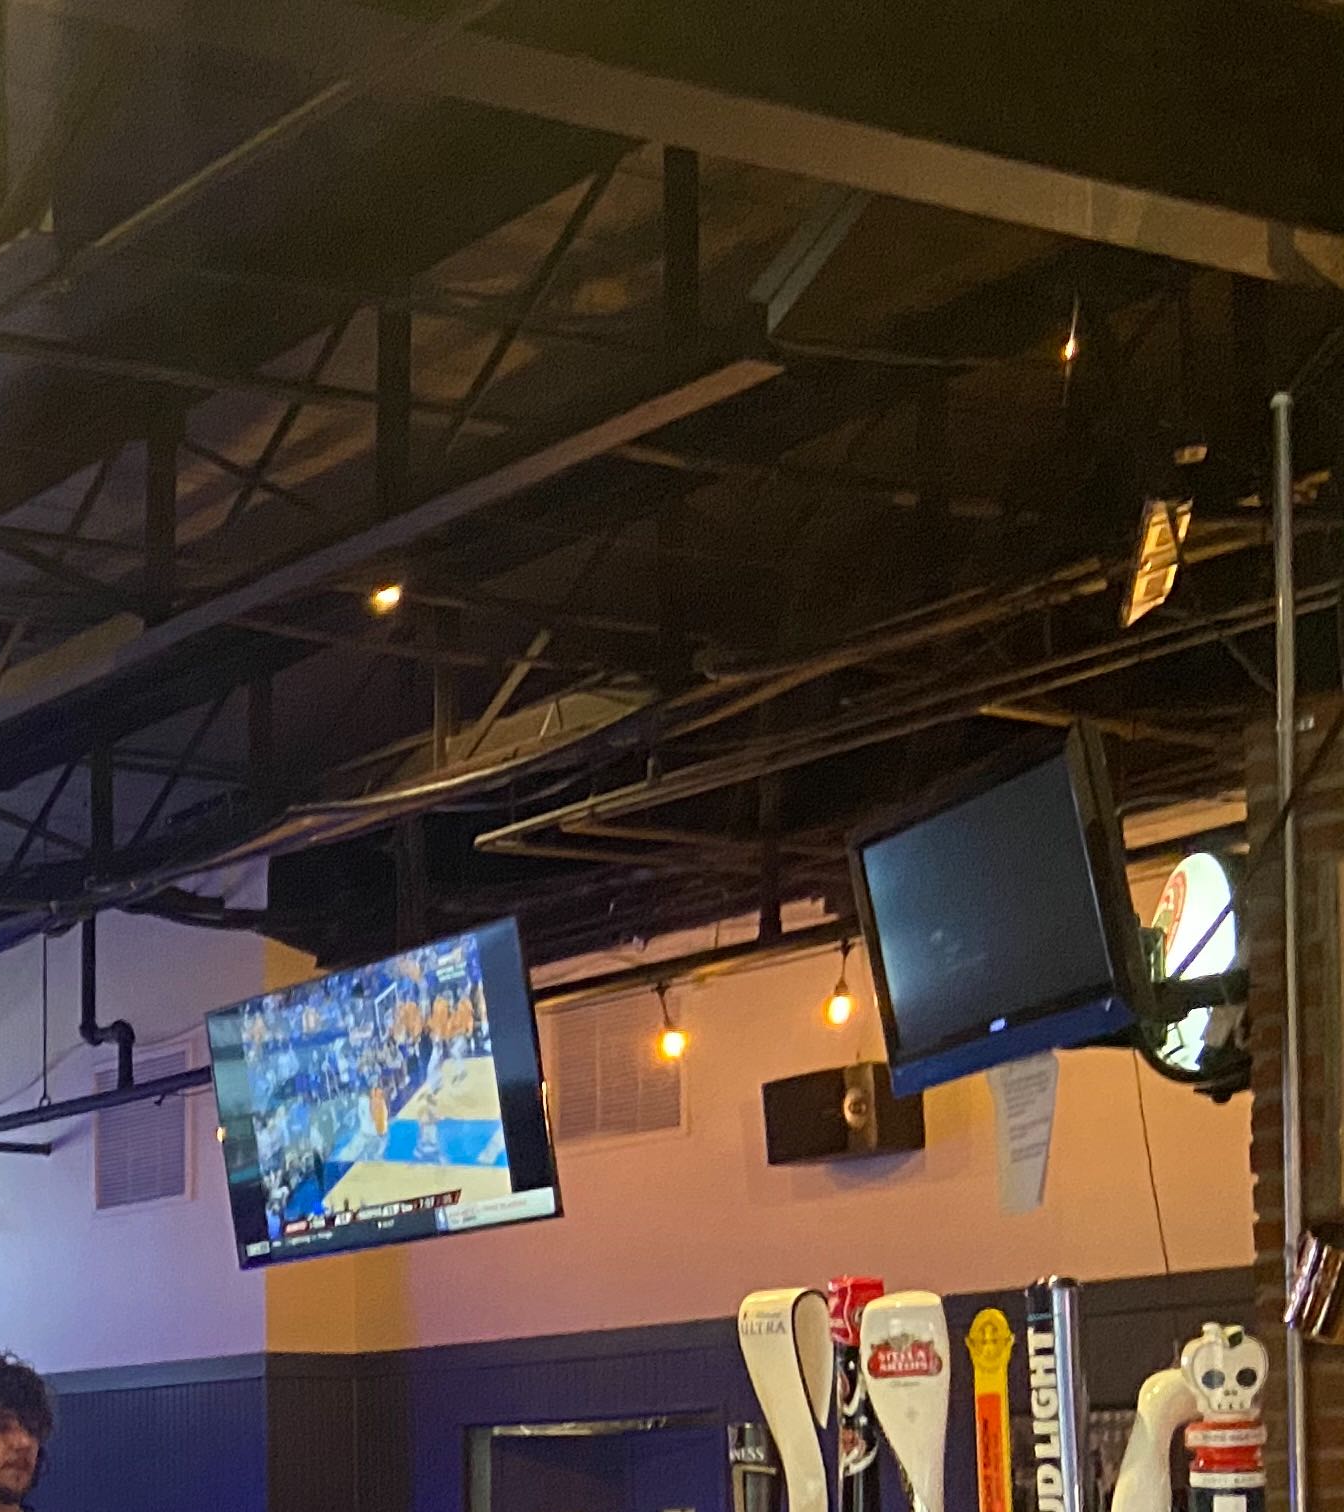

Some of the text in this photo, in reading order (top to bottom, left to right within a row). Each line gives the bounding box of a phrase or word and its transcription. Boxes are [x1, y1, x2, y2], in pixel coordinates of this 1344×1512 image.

[741, 1320, 786, 1335] ULTRA
[877, 1350, 927, 1362] STELLA
[879, 1361, 928, 1371] ARTOIS
[1027, 1327, 1060, 1459] LIGHT
